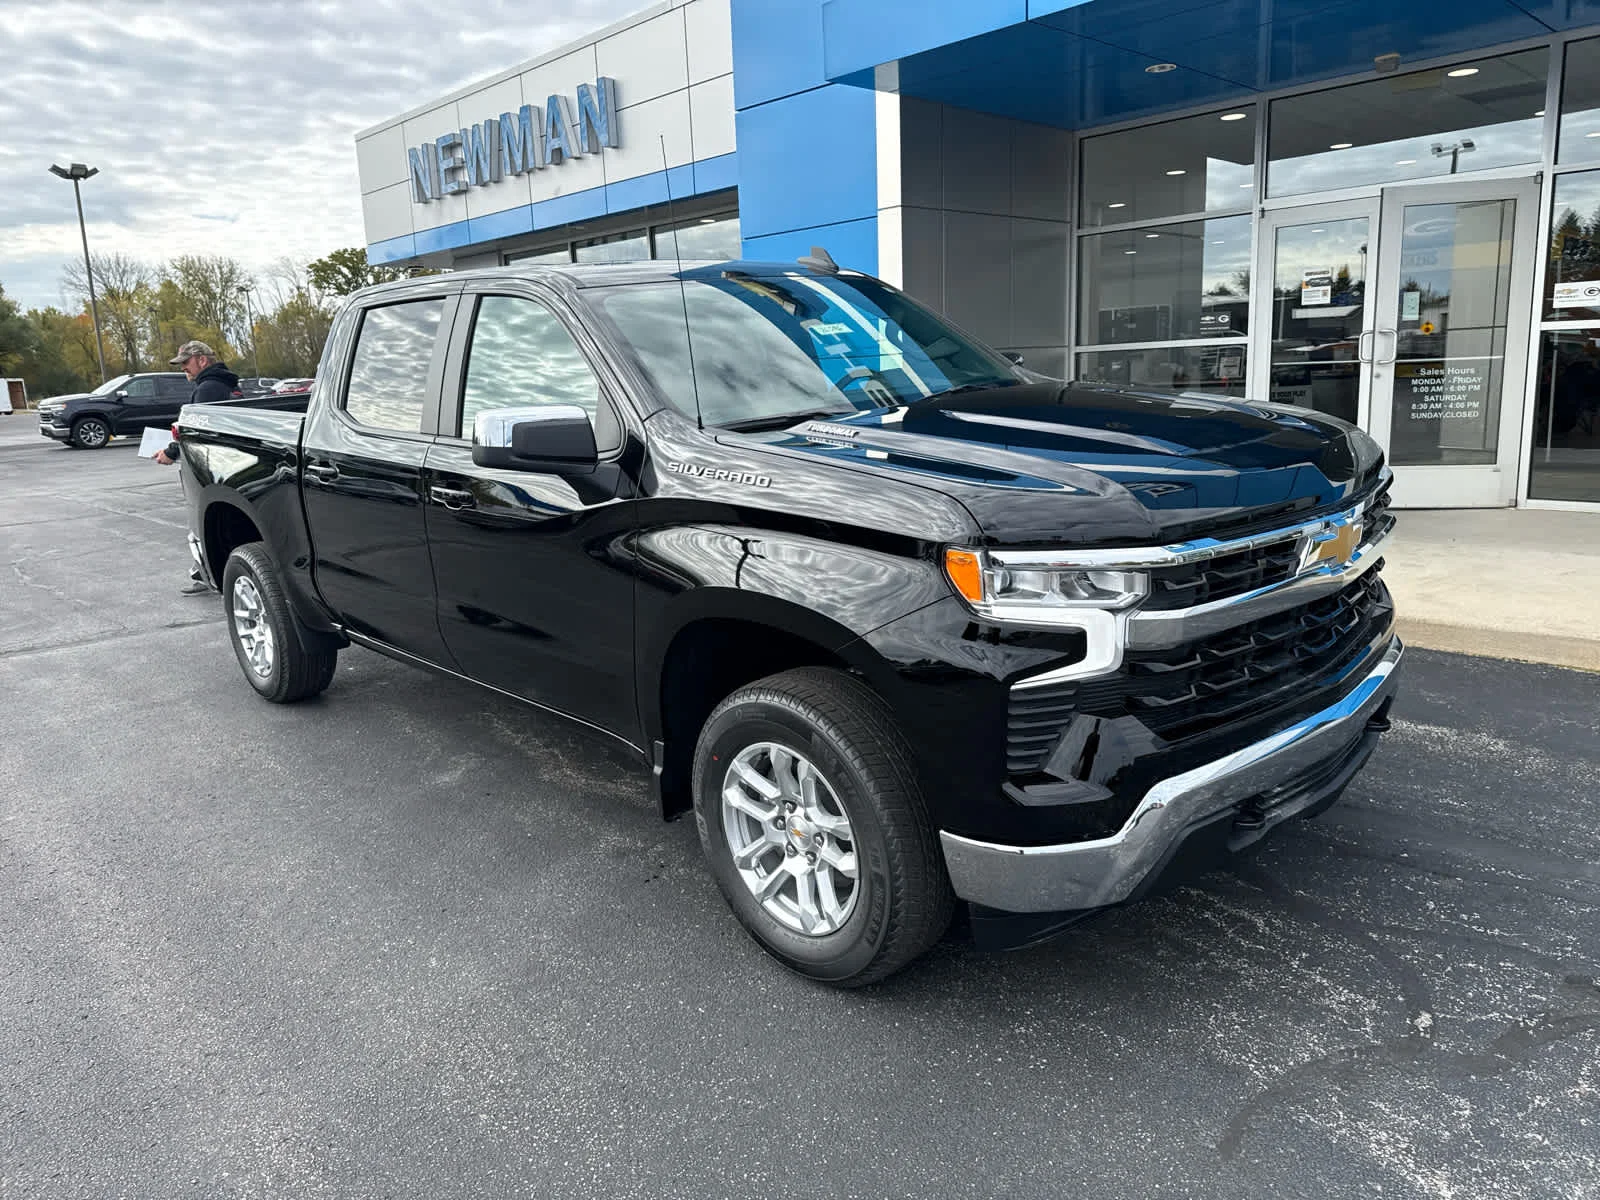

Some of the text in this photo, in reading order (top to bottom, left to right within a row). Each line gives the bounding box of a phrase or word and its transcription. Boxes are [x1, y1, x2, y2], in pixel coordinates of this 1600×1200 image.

[408, 76, 619, 204] NEWMAN
[1420, 367, 1476, 376] Sales Hours
[1452, 376, 1482, 384] FRIDAY
[1430, 385, 1443, 393] AM
[1467, 384, 1481, 392] PM
[1423, 394, 1468, 402] SATURDAY
[1428, 402, 1442, 410] AM
[1466, 401, 1480, 409] PM
[666, 461, 772, 489] SILVERADO
